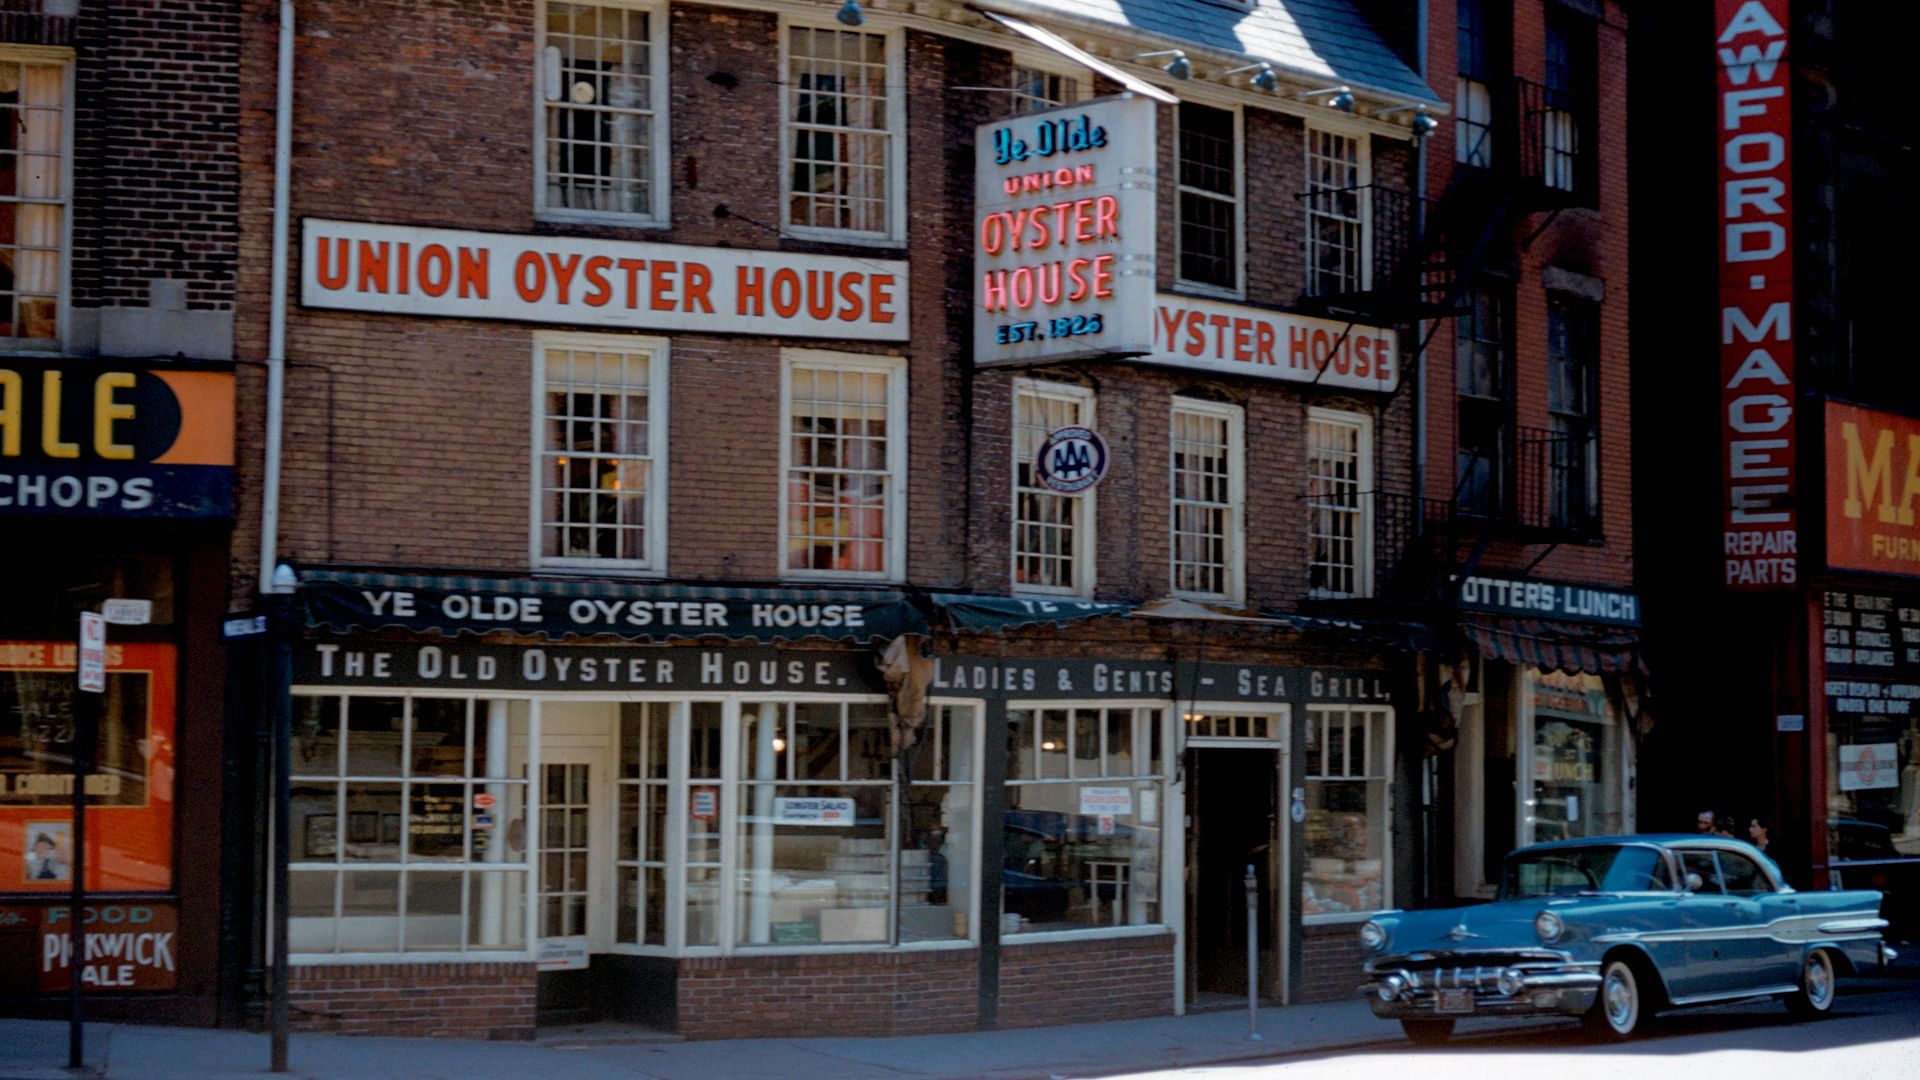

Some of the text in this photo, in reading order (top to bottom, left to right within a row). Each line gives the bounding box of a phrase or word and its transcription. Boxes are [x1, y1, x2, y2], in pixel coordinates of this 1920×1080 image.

[994, 115, 1107, 164] Ye Olde
[1003, 164, 1094, 195] UNION
[981, 195, 1119, 255] OYSTER
[317, 237, 896, 323] UNION OYSTER HOUSE
[984, 254, 1115, 313] HOUSE
[997, 314, 1103, 344] EST. 1826
[1154, 306, 1391, 380] YSTER HOUSE
[1721, 301, 1792, 524] MAGEE
[1054, 441, 1091, 478] AAA
[1723, 529, 1798, 556] REPAIR
[1725, 558, 1797, 585] PARTS
[361, 590, 865, 628] YE OLDE OYSTER HOUSE
[315, 643, 847, 685] THE OLD OYSTER HOUSE.
[932, 657, 1036, 691] LADIES
[1057, 668, 1073, 691] &
[1093, 663, 1174, 694] GENTS
[1237, 668, 1286, 696] SEA
[47, 905, 154, 924] FOOD
[42, 931, 175, 972] PIKWICK
[80, 964, 136, 987] ALE
